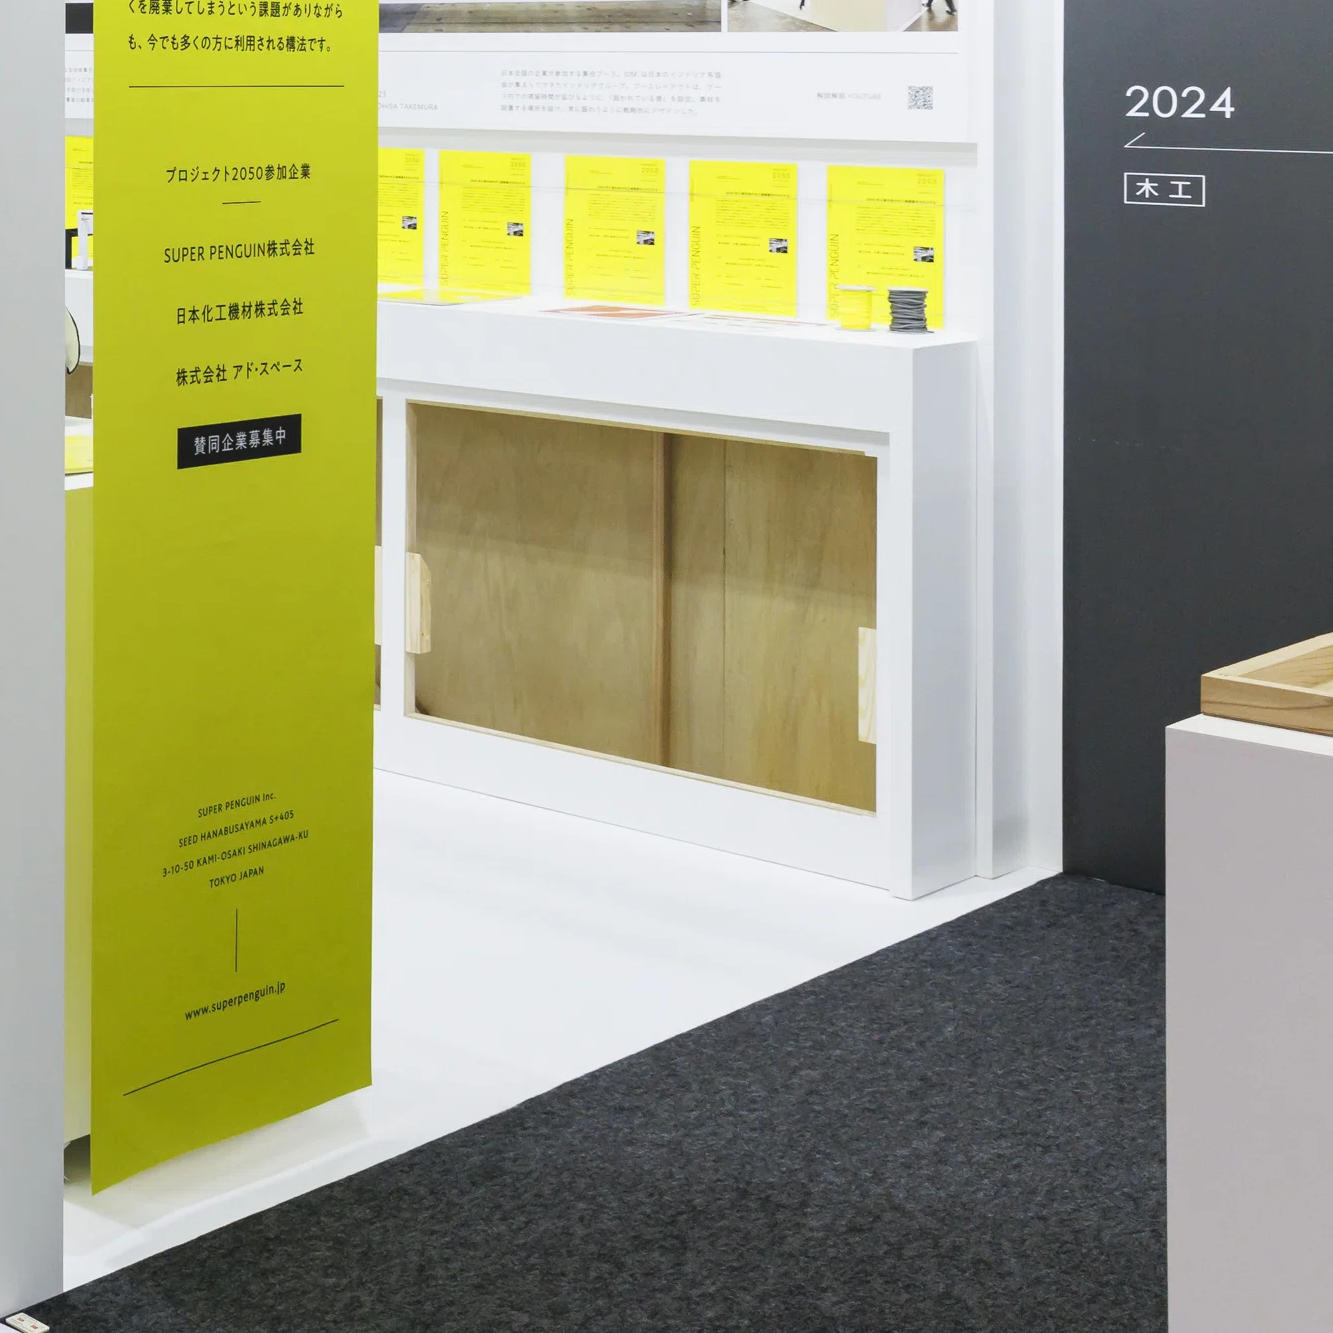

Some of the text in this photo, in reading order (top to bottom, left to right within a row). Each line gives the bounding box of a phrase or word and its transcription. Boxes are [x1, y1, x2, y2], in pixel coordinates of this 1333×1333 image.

[1125, 84, 1235, 119] 2024
[165, 163, 311, 184] プロジェクト2050参加企業
[1135, 177, 1192, 199] 木工
[164, 238, 315, 264] SUPER PENGUIN株式会社
[691, 225, 701, 270] PENGUIN
[177, 297, 304, 325] 日本化工機材株式会社
[176, 359, 303, 387] 株式会社 アド・スペース
[194, 425, 287, 456] 賛同企業募集中
[197, 791, 277, 818] SUPER PENGUIN Inc.
[178, 834, 198, 848] SEED
[200, 816, 267, 842] HANABUSAYAMA
[162, 829, 309, 878] 3-10-50 KAMI-OSAKI SHINAGAWA-KU
[209, 865, 265, 888] TOKYO JAPAN
[184, 980, 286, 1021] www.superpenguin.jp
